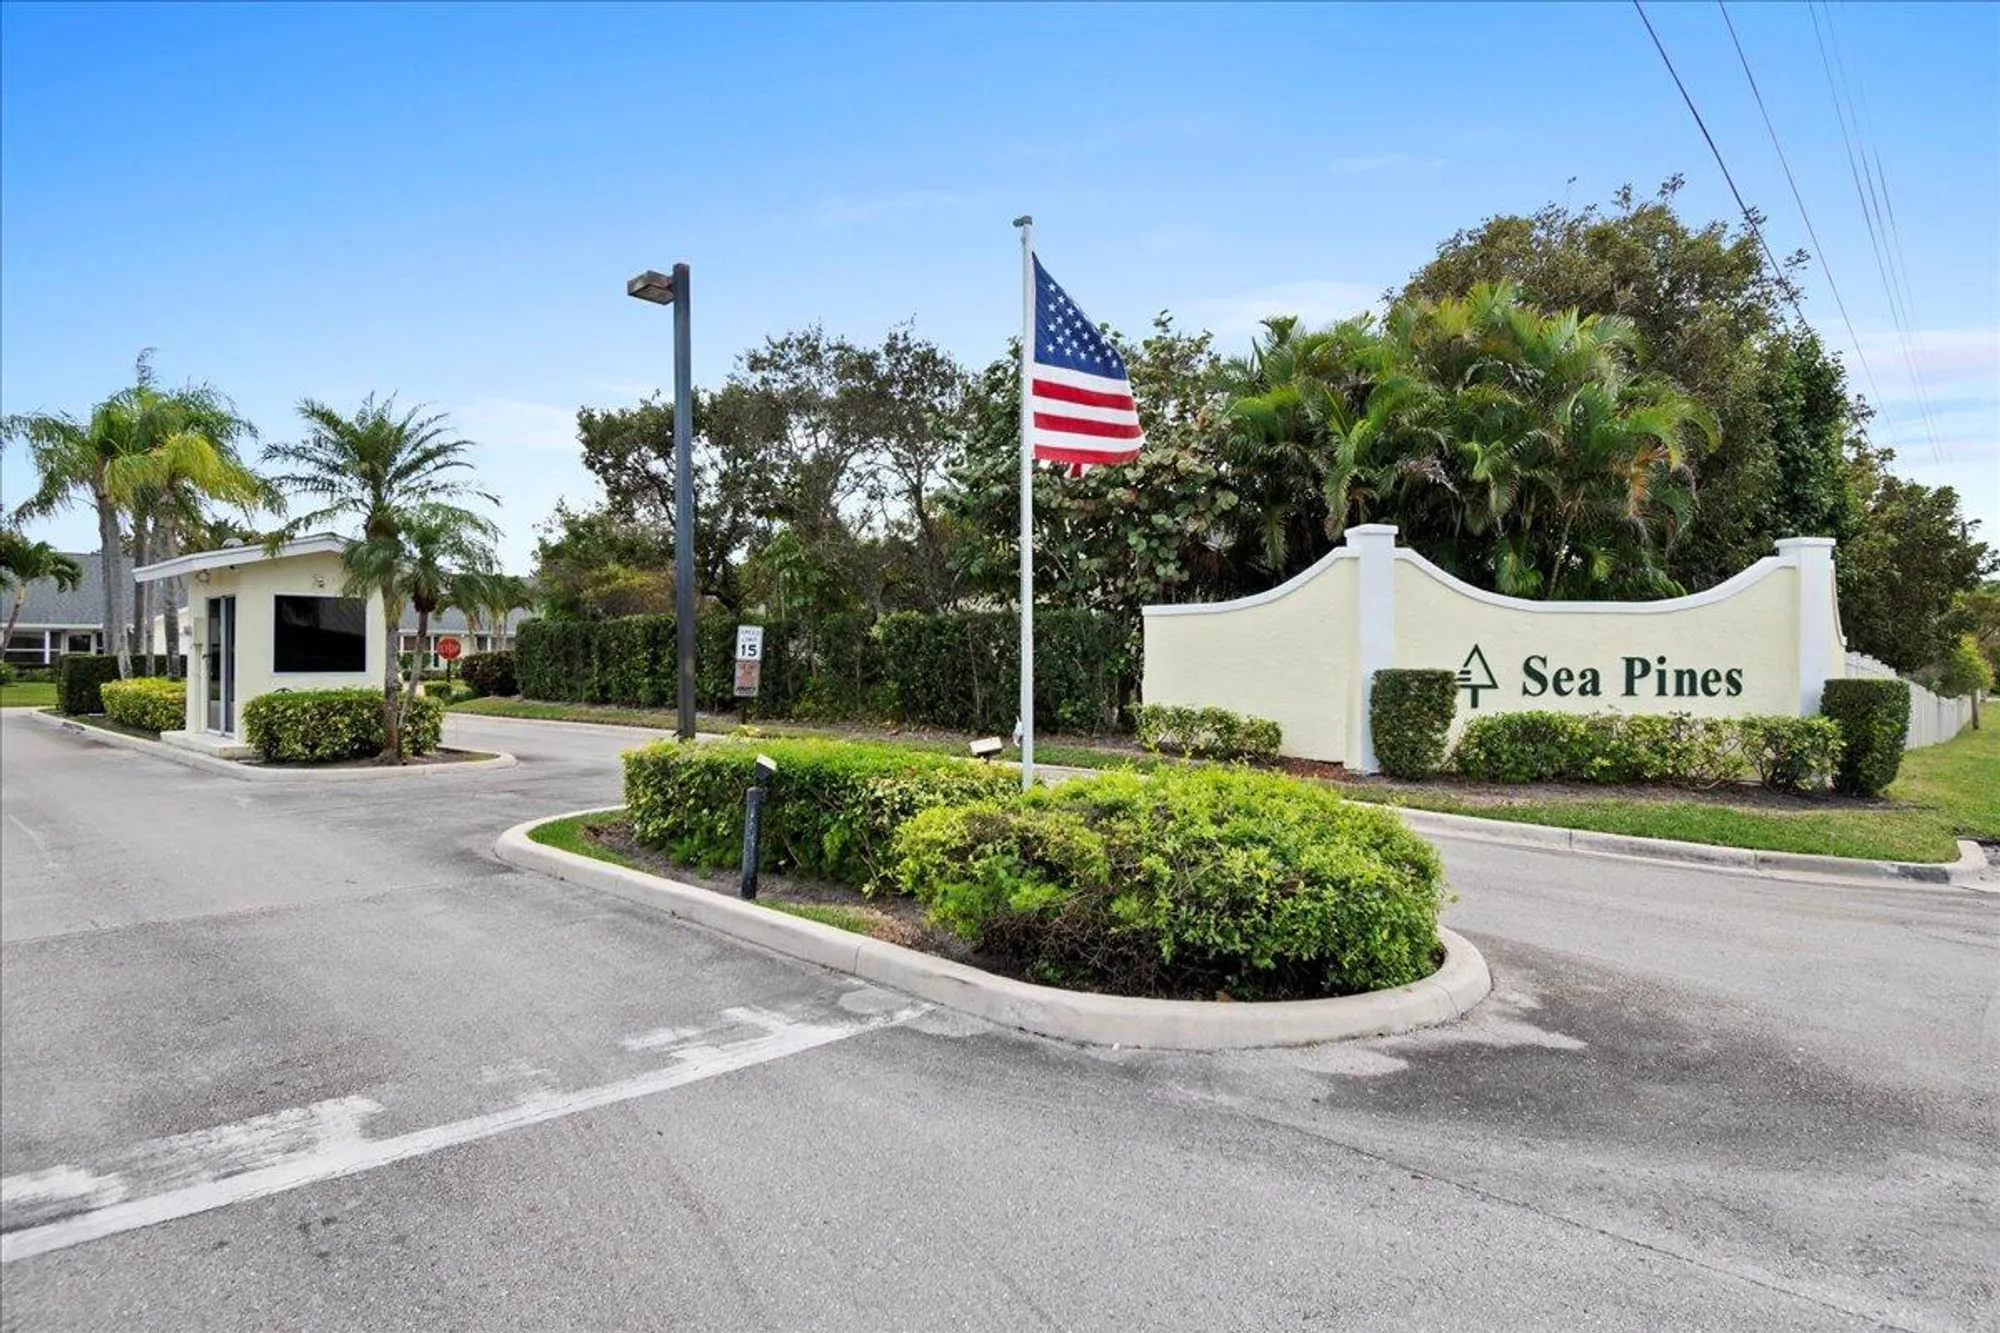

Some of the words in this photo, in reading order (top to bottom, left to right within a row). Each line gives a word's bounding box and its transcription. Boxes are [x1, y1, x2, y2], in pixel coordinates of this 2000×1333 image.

[741, 644, 757, 657] 15
[1521, 654, 1602, 697] Sea
[1621, 655, 1743, 697] Pines
